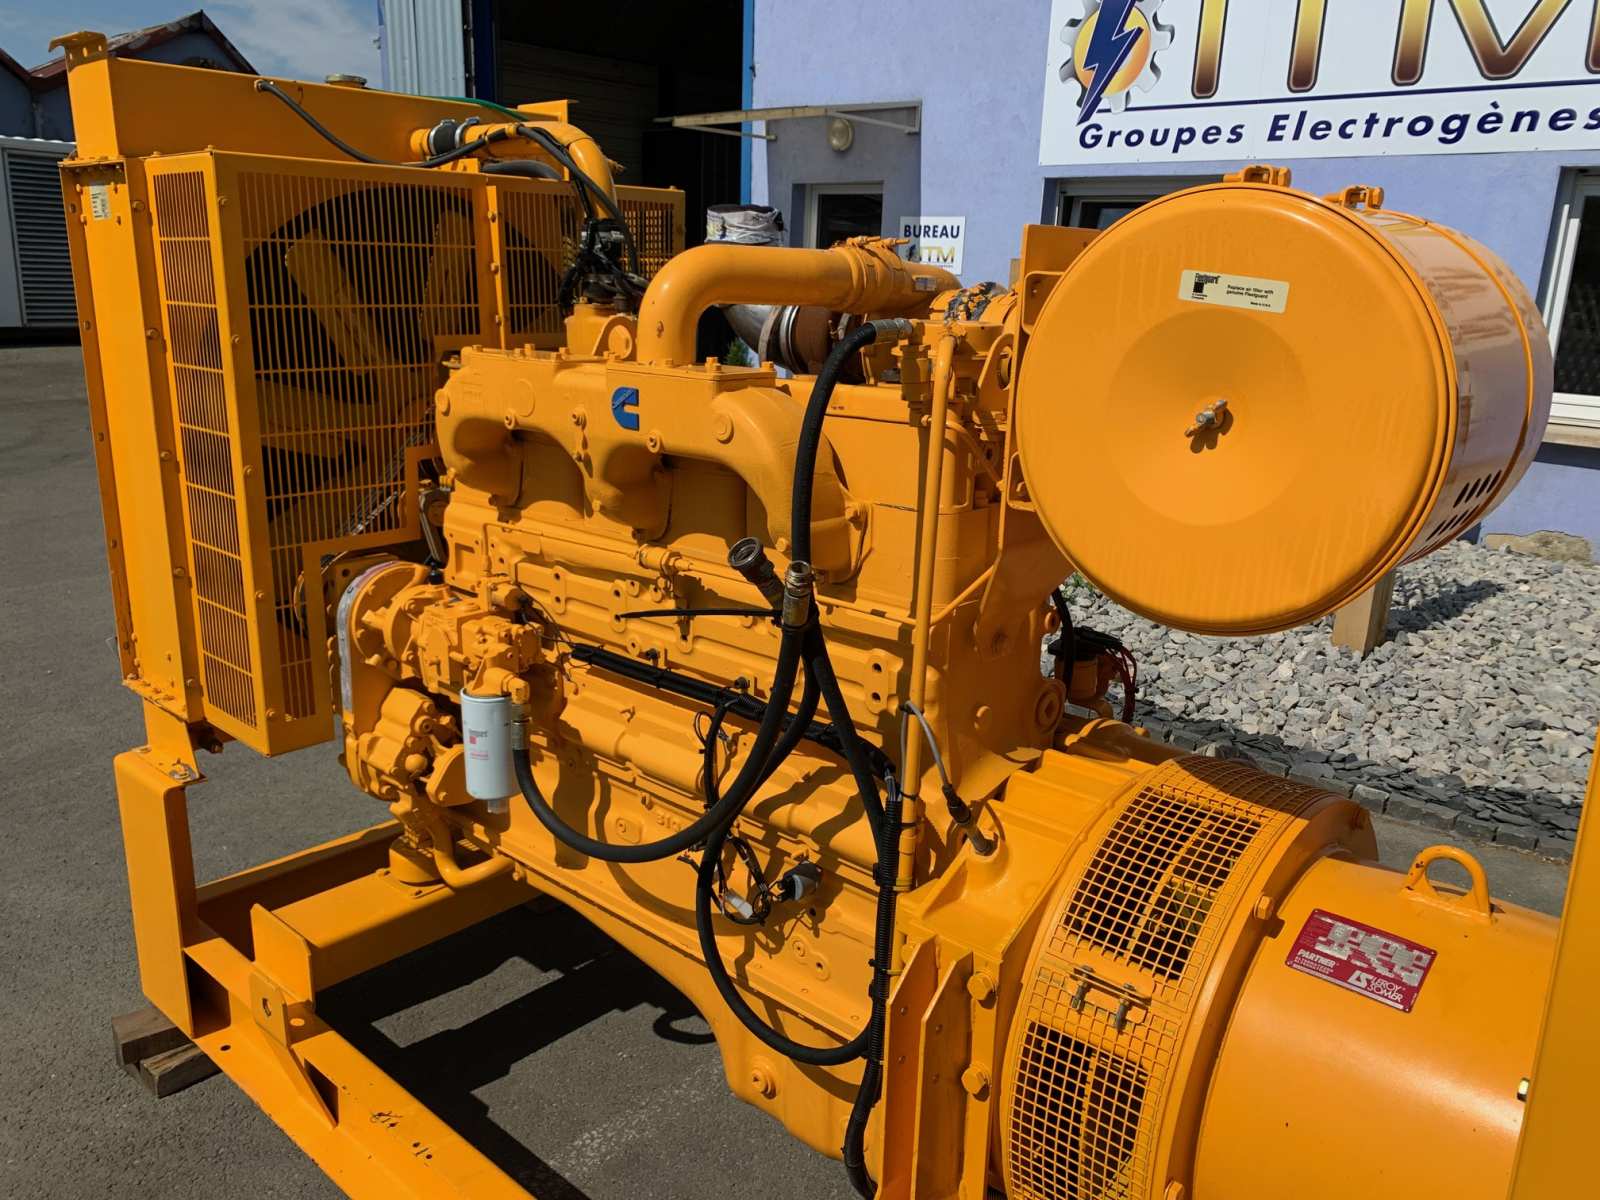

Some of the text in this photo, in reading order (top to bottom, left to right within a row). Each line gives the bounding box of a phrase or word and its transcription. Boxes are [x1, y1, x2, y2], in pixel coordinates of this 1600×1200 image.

[1078, 101, 1600, 154] Groupes Electrogènes
[904, 224, 960, 239] BUREAU
[1297, 949, 1336, 968] PARTNER
[1367, 983, 1403, 1002] SOMER
[1371, 977, 1402, 992] LEROY
